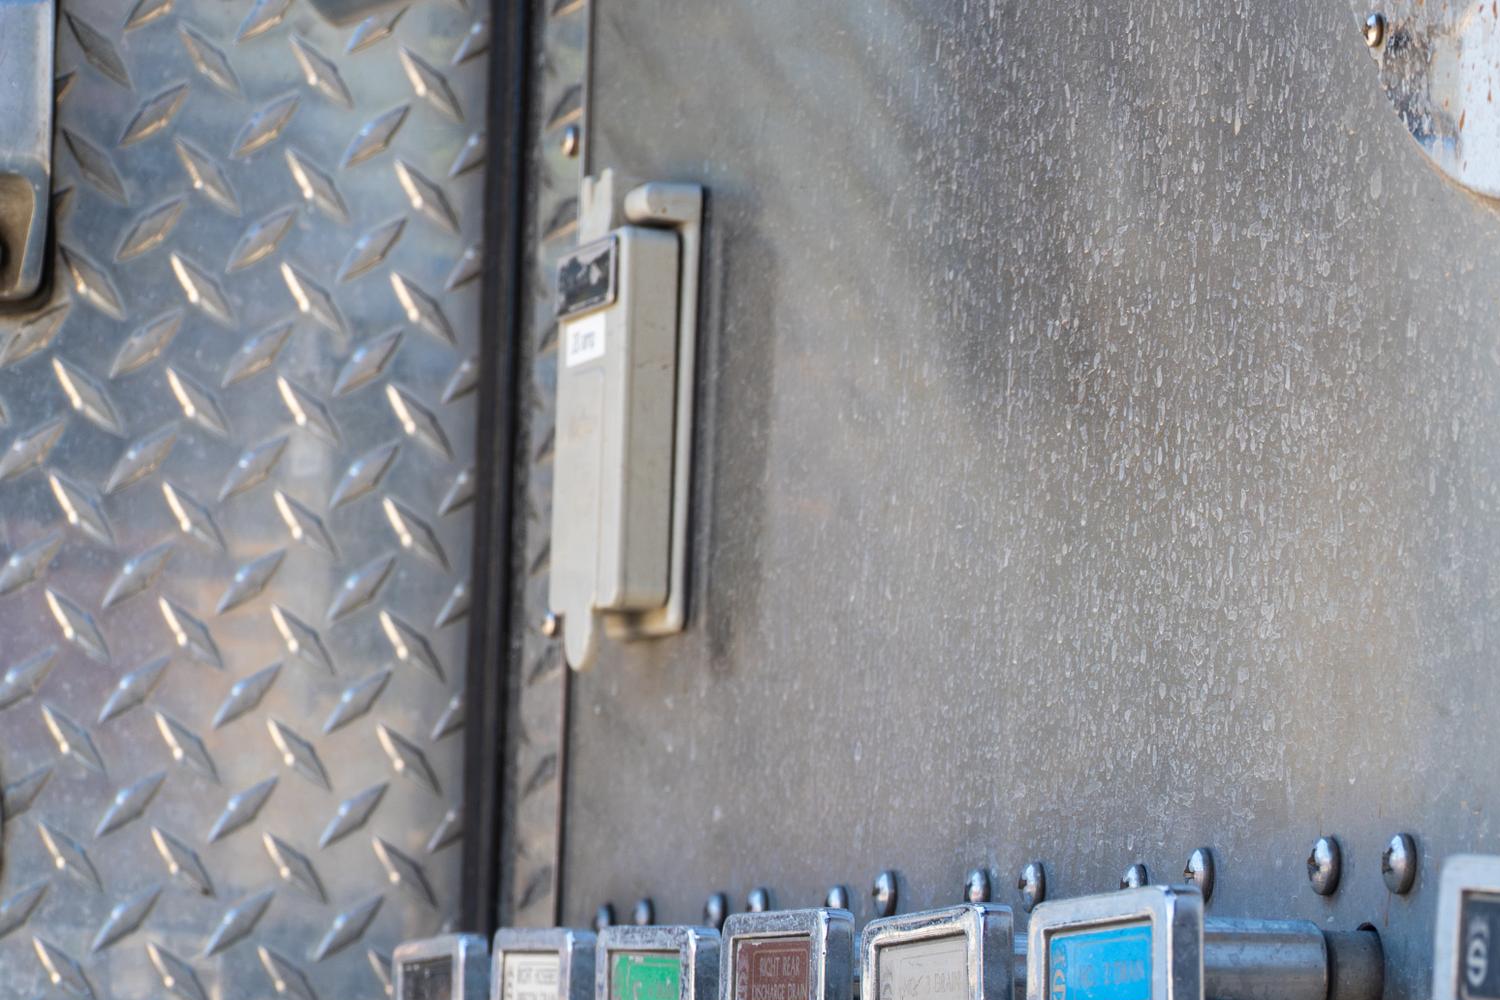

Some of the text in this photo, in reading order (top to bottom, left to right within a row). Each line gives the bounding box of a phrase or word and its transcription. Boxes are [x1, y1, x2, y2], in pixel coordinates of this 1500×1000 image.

[759, 955, 801, 977] RIGHT REAR
[752, 983, 808, 1000] DISCHARGE DRAIN
